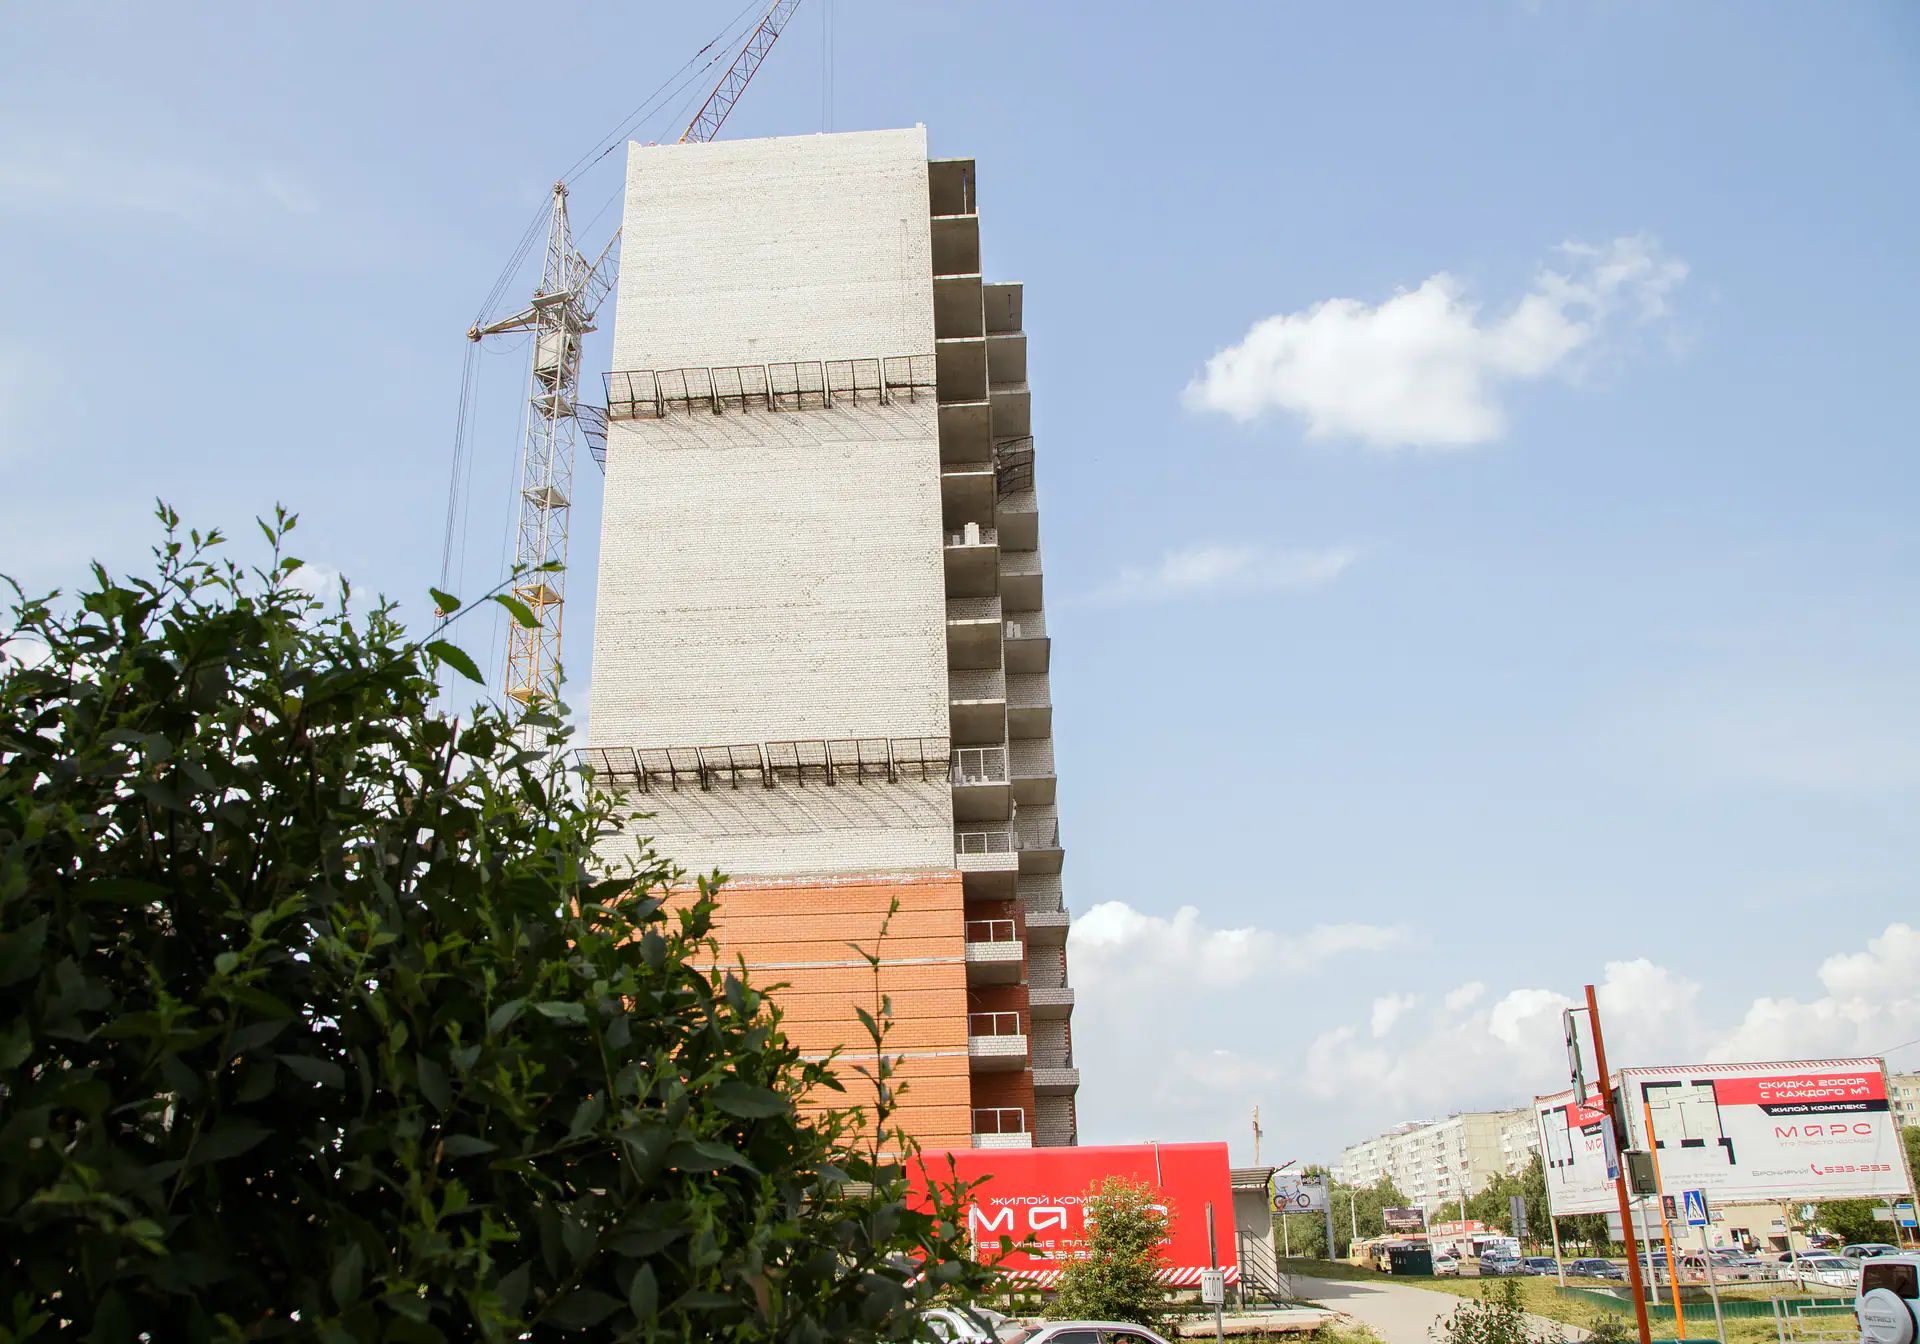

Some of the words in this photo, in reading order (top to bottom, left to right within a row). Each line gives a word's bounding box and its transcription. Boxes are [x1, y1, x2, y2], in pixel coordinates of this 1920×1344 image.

[1758, 1079, 1815, 1089] СКИДКА
[1760, 1091, 1770, 1099] С
[1775, 1088, 1845, 1098] КАЖДОГО
[1770, 1104, 1808, 1113] ЖИЛОЙ
[1810, 1103, 1867, 1111] КОМПЛЕКС
[1775, 1122, 1872, 1138] МАРС
[1824, 1164, 1891, 1173] 533-233
[990, 1195, 1051, 1205] ЖИЛОЙ
